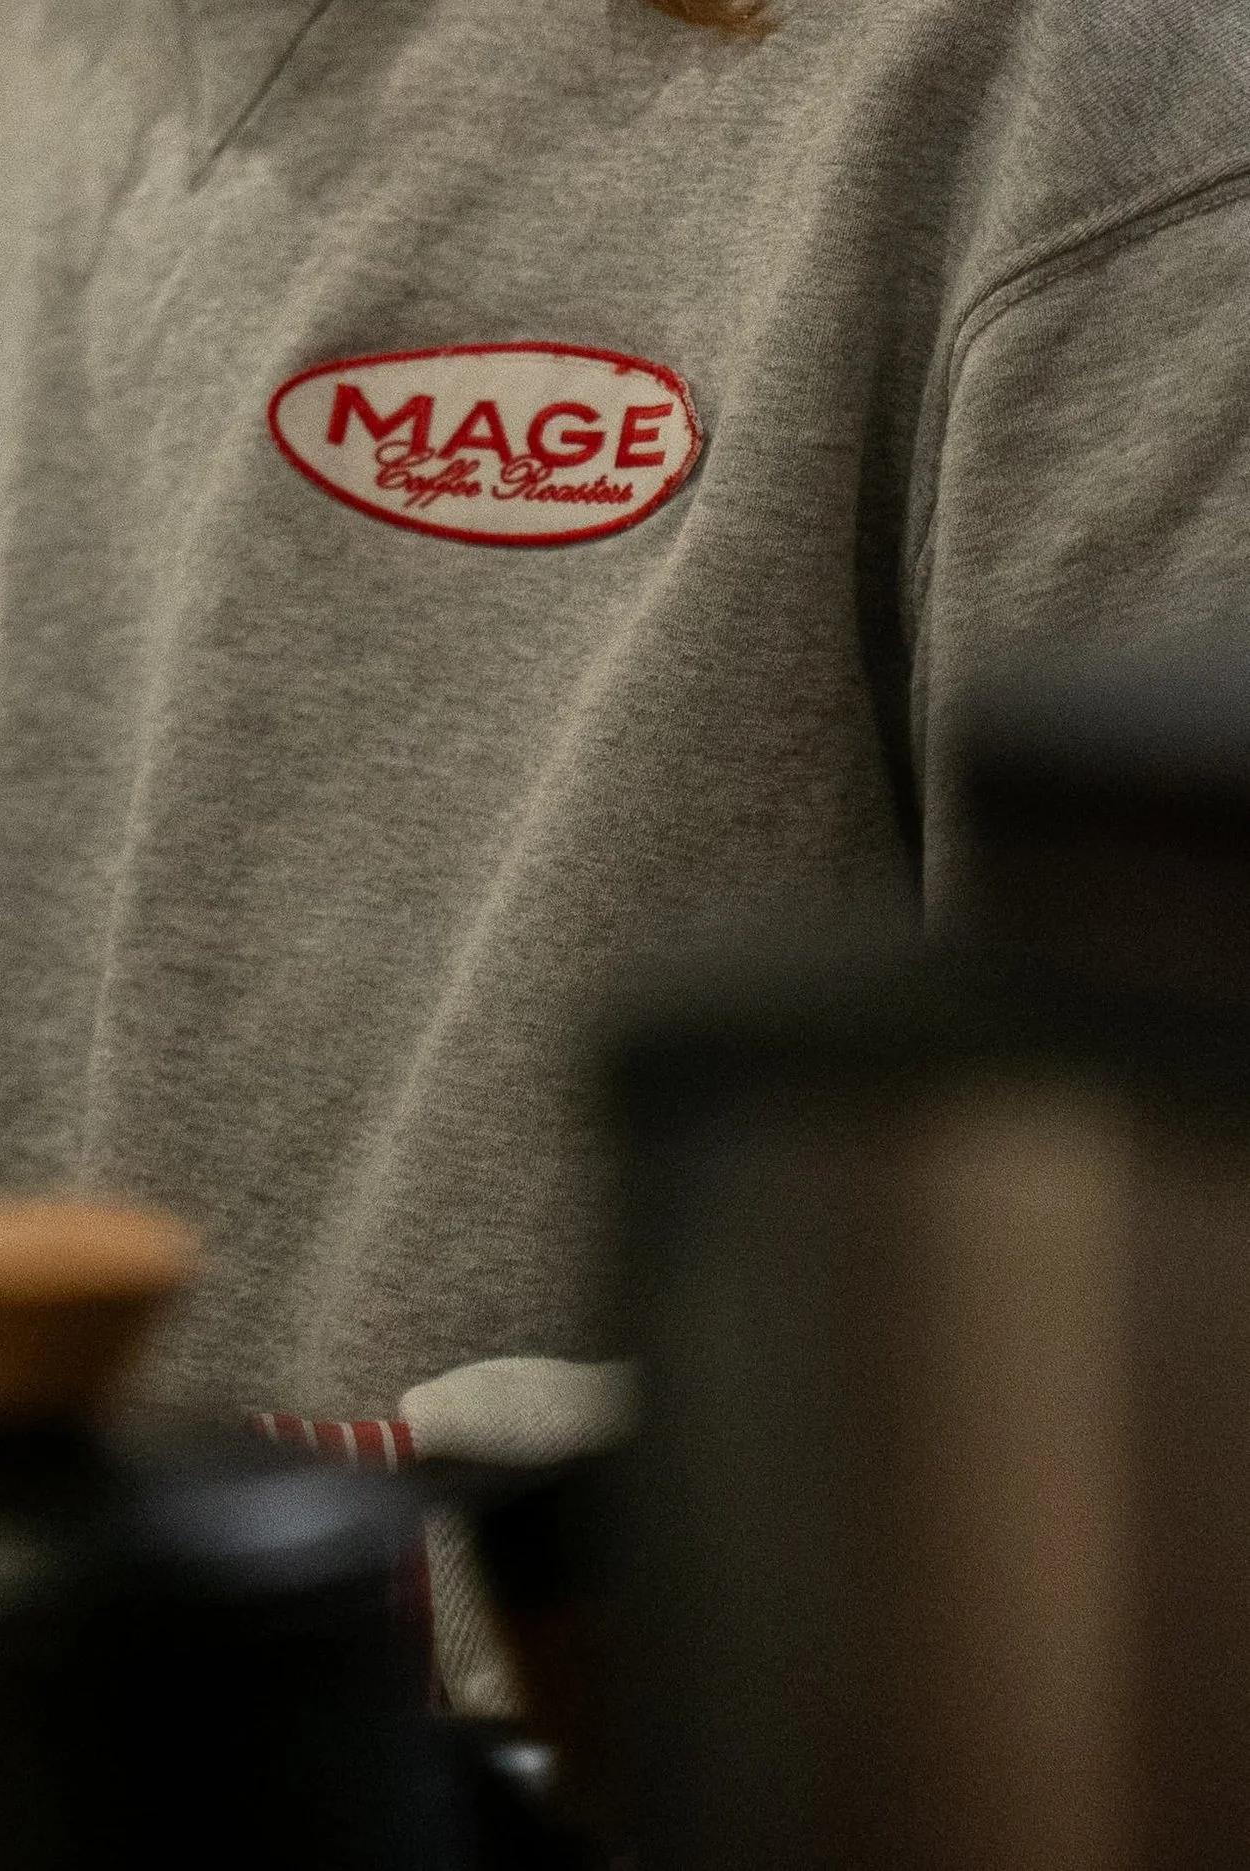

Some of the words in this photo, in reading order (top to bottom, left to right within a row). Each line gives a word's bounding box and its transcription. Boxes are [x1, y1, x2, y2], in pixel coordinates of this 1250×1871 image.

[326, 383, 674, 469] MAGE
[375, 440, 481, 508] Coffee
[491, 454, 634, 505] Roasters
